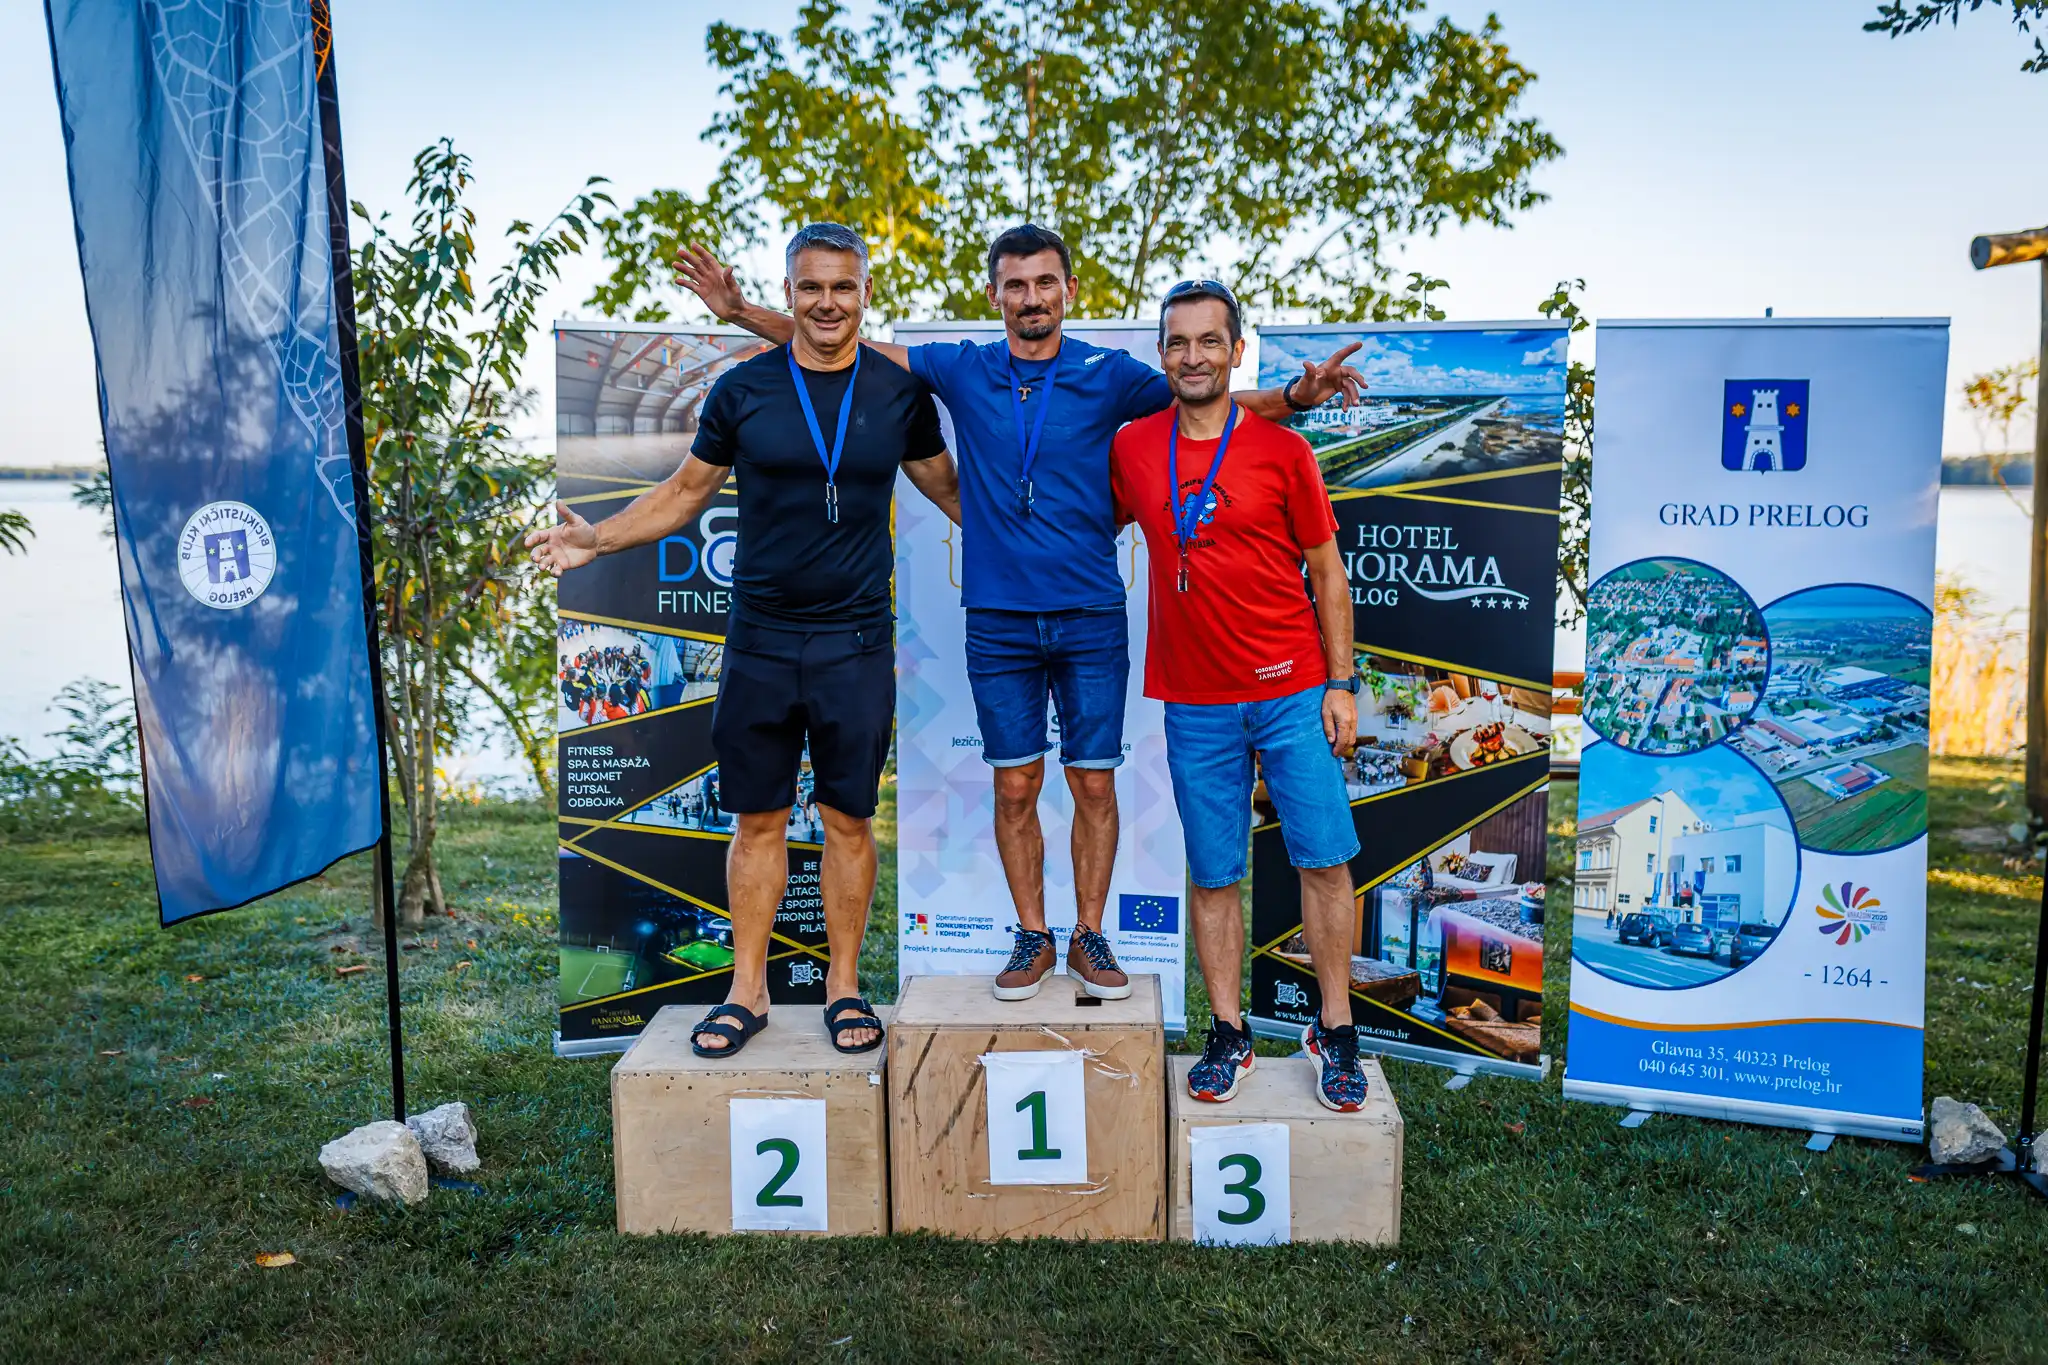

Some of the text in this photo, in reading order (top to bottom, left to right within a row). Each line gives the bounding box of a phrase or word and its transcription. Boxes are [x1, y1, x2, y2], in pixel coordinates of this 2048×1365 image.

[1659, 502, 1869, 528] GRAD PRELOG
[1357, 524, 1459, 550] HOTEL
[568, 746, 614, 756] FITNESS
[568, 756, 650, 769] SPA & MASAŽA
[568, 771, 622, 781] RUKOMET
[568, 785, 611, 794] FUTSAL
[568, 797, 624, 807] ODBOJKA
[936, 914, 967, 922] Operativni
[800, 923, 827, 933] PILAT
[936, 922, 993, 930] KONKURENTNOST
[940, 930, 970, 938] KOHEZIJA
[904, 944, 930, 953] Projekt
[931, 945, 938, 953] je
[940, 946, 984, 955] sufinancirala
[1118, 953, 1153, 963] regionalni
[1822, 965, 1872, 988] 1264
[1652, 1040, 1831, 1076] Glavna 35, 40323 Prelog
[1639, 1058, 1842, 1095] 040 645 301, www.prelog.hr
[1015, 1090, 1062, 1160] 1
[756, 1137, 803, 1207] 2
[1217, 1153, 1266, 1225] 3
